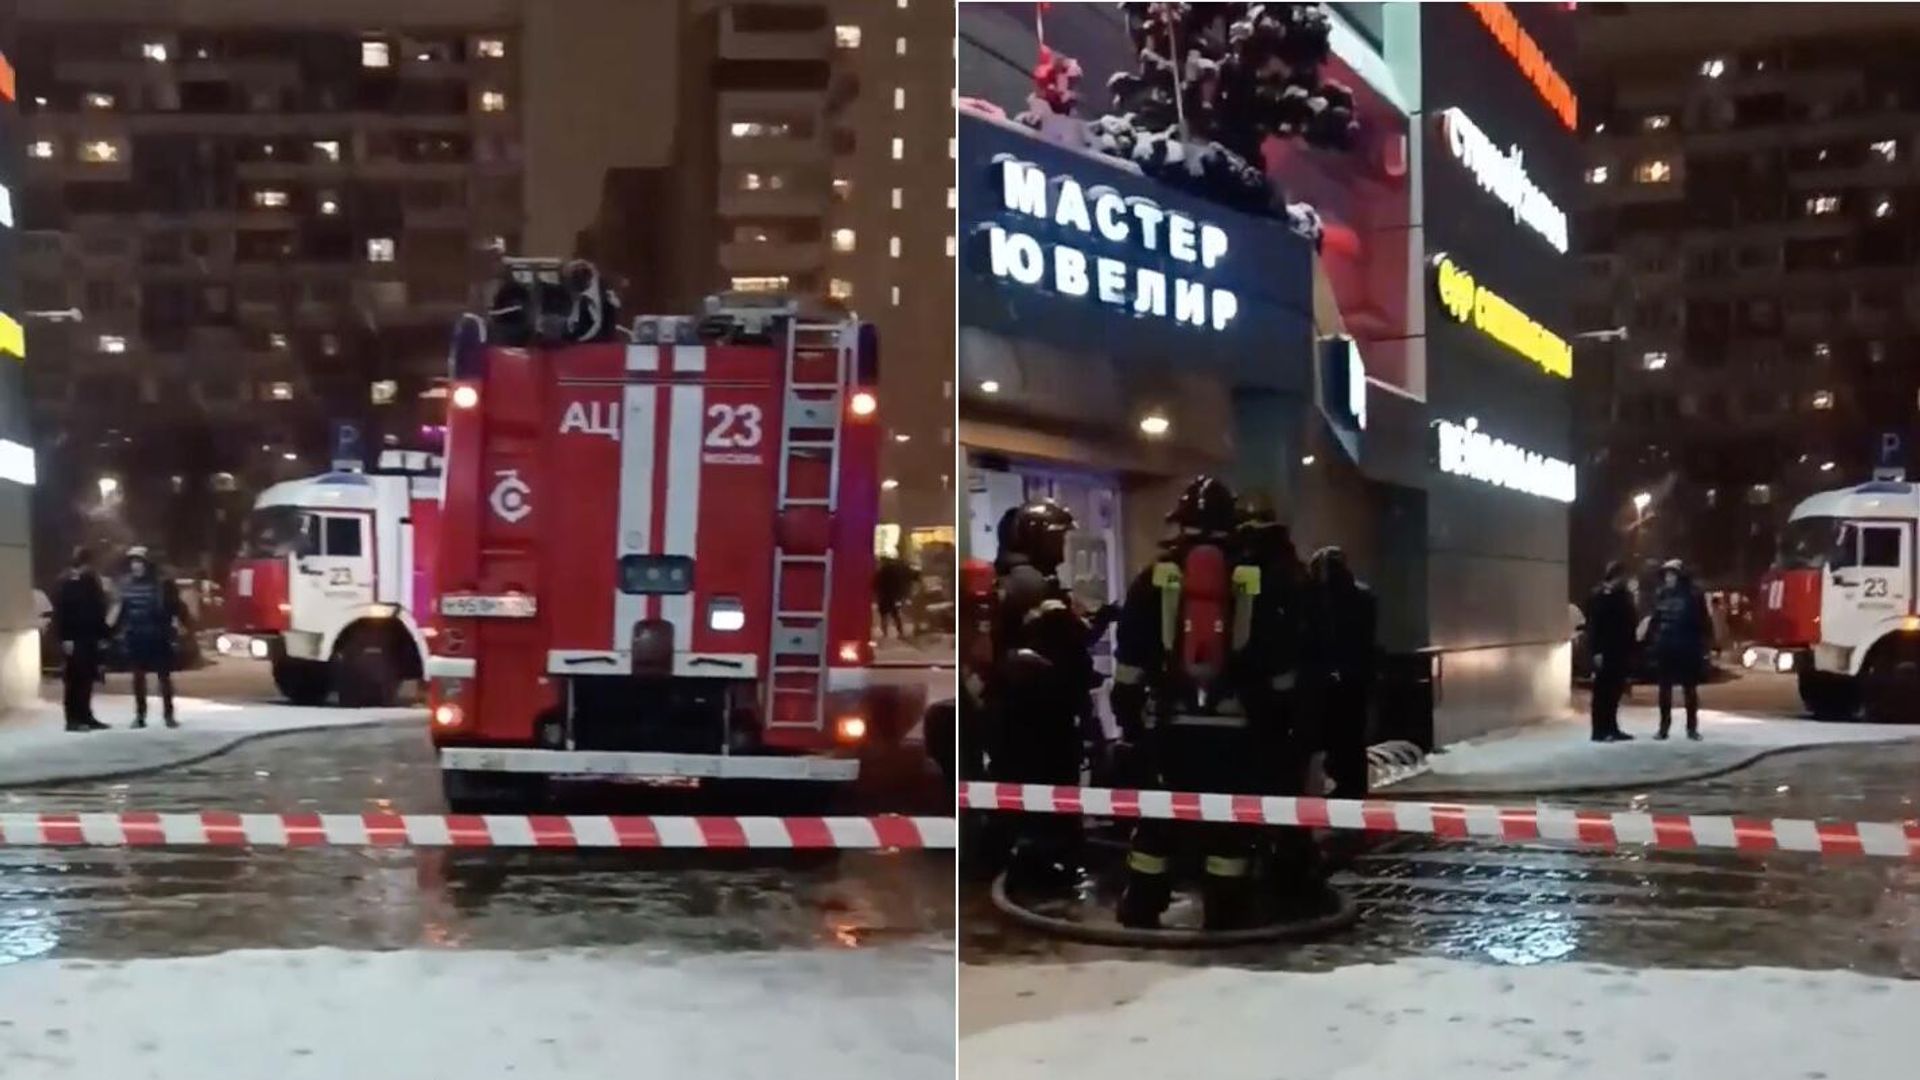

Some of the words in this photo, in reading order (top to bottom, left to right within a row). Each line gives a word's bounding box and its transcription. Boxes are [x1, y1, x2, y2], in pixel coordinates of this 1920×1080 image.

[1003, 160, 1229, 268] МАСТЕР
[989, 226, 1237, 331] ЮВЕЛИР
[560, 401, 620, 441] АЦ
[704, 404, 763, 447] 23
[1864, 578, 1888, 597] 23
